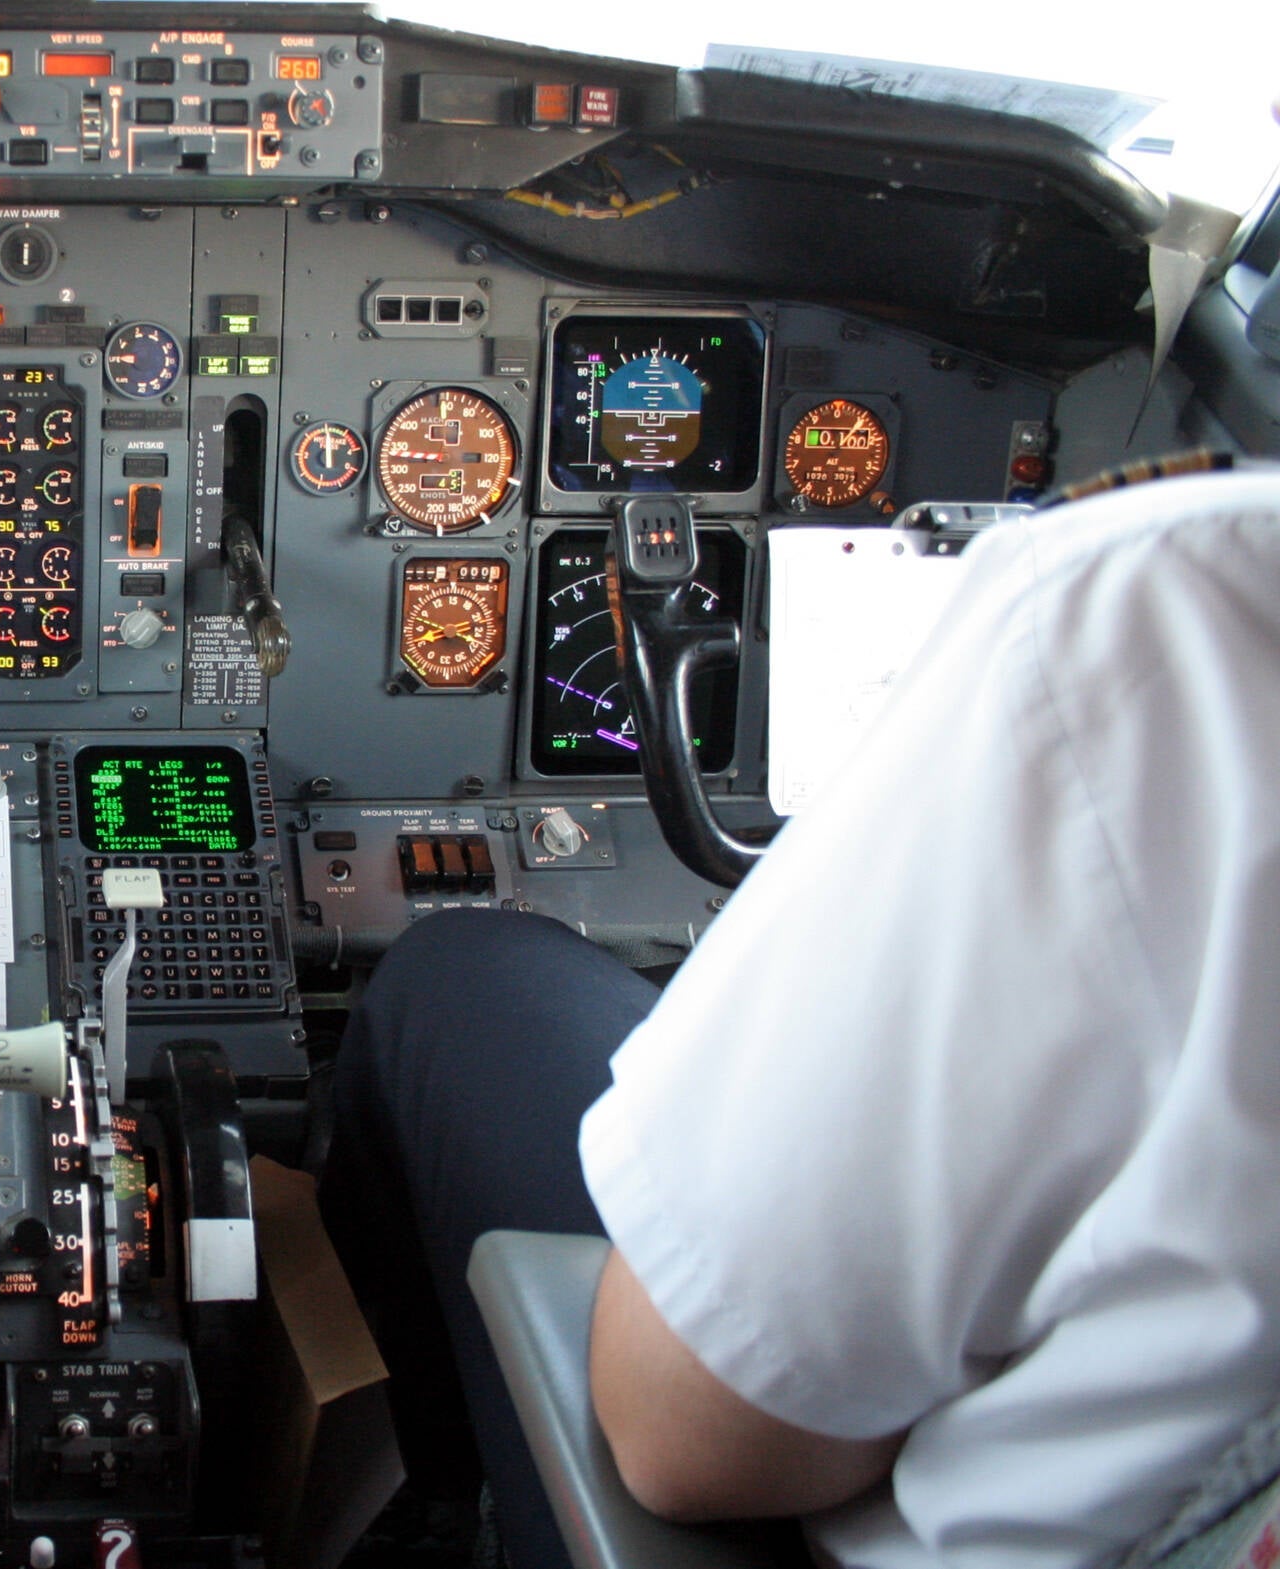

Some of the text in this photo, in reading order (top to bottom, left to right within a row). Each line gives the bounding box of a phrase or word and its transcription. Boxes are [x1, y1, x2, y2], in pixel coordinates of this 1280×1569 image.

[51, 34, 104, 44] VERT SPEED
[160, 33, 224, 45] A/P ENGAGE
[281, 37, 314, 47] COURSE
[280, 61, 317, 79] 260
[589, 90, 607, 101] FIRE
[586, 101, 609, 111] WARN
[168, 127, 214, 136] DISENGAGE
[22, 209, 60, 218] DAMPER
[62, 290, 70, 303] 2
[711, 337, 721, 346] FD
[208, 358, 228, 366] LEFT
[25, 371, 43, 383] 23
[577, 368, 588, 376] 80
[576, 392, 587, 400] 60
[463, 408, 475, 417] 80
[575, 415, 586, 424] 40
[400, 421, 418, 431] 400
[479, 428, 494, 438] 100
[391, 442, 408, 452] 350
[484, 454, 499, 463] 120
[390, 465, 408, 474] 300
[398, 484, 416, 493] 250
[477, 479, 491, 488] 140
[462, 495, 477, 505] 160
[426, 503, 444, 513] 200
[448, 503, 462, 512] 180
[45, 520, 60, 532] 75
[42, 656, 59, 667] 93
[103, 761, 183, 769] ACT RTE LEGS
[52, 1099, 62, 1109] 5
[52, 1134, 69, 1147] 10
[53, 1158, 71, 1172] 15
[53, 1190, 74, 1205] 25
[54, 1235, 78, 1250] 30
[5, 1274, 32, 1282] HORN
[0, 1283, 37, 1293] CUTOUT
[58, 1291, 80, 1307] 40
[64, 1321, 96, 1331] FLAP
[63, 1332, 96, 1343] DOWN
[62, 1365, 129, 1377] STAB TRIM
